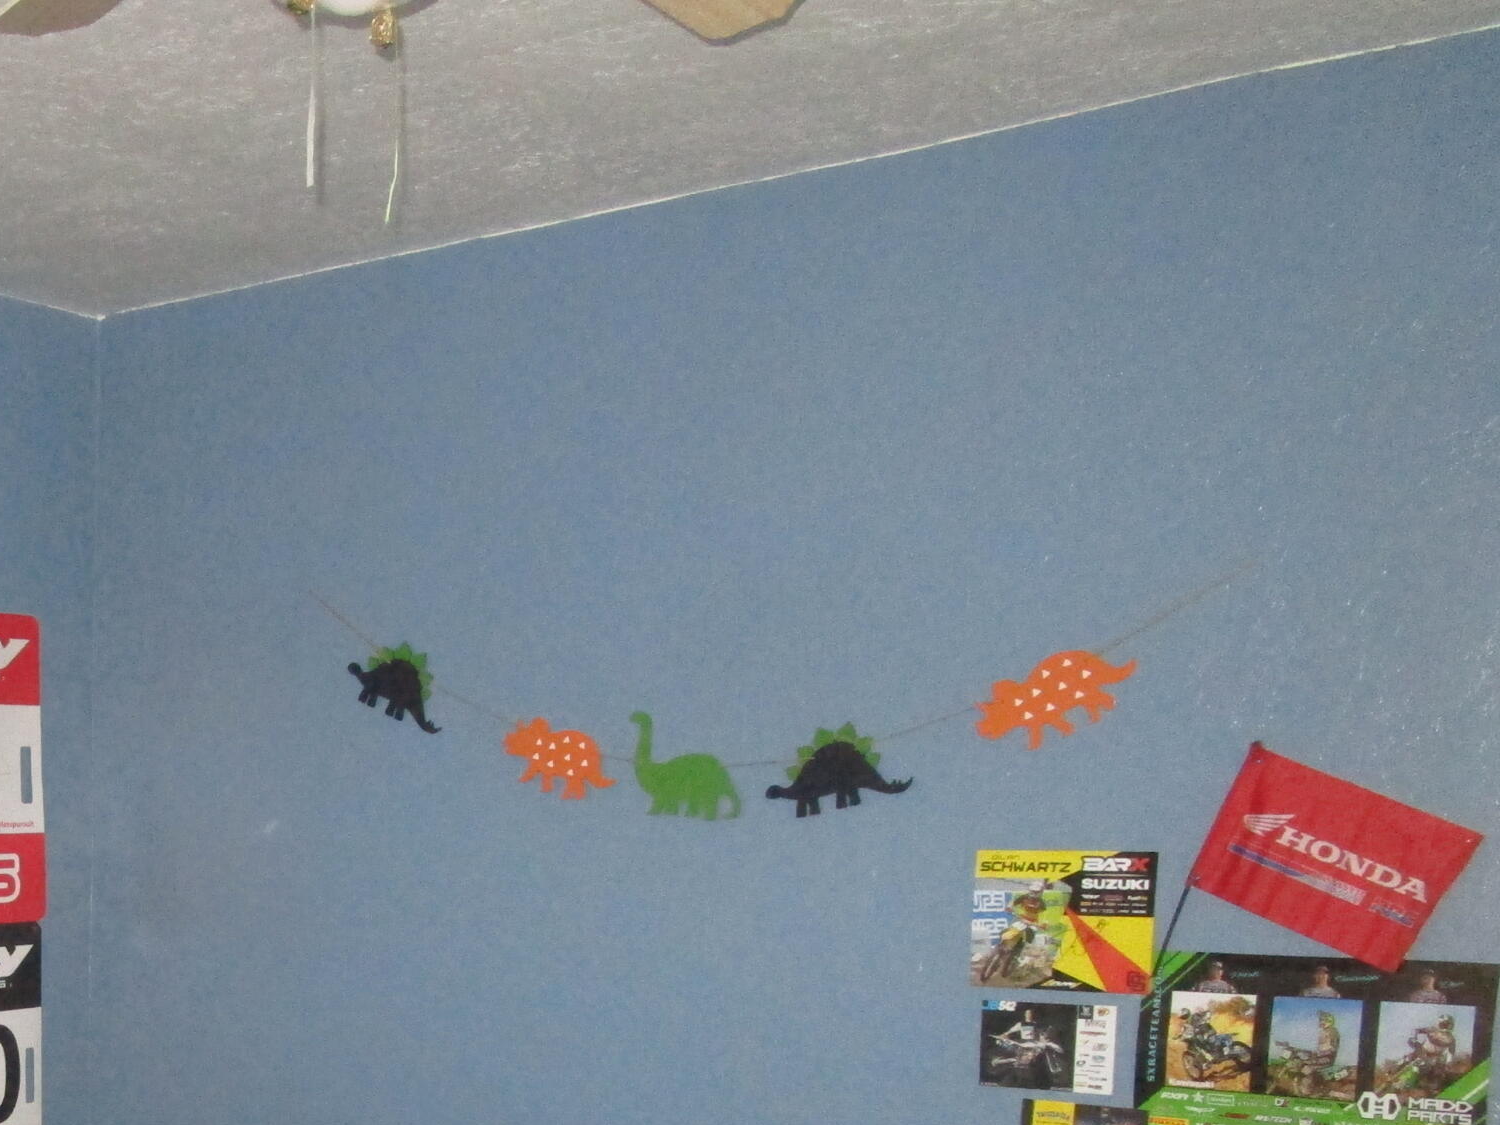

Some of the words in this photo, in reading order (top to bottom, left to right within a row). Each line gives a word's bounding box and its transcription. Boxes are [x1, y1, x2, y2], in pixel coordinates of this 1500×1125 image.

[980, 861, 1072, 873] SCHWARTZ
[1276, 826, 1428, 903] HONDA
[1081, 878, 1150, 891] SUZUKI
[1408, 1096, 1473, 1114] MADD
[1407, 1109, 1473, 1125] PARTS
